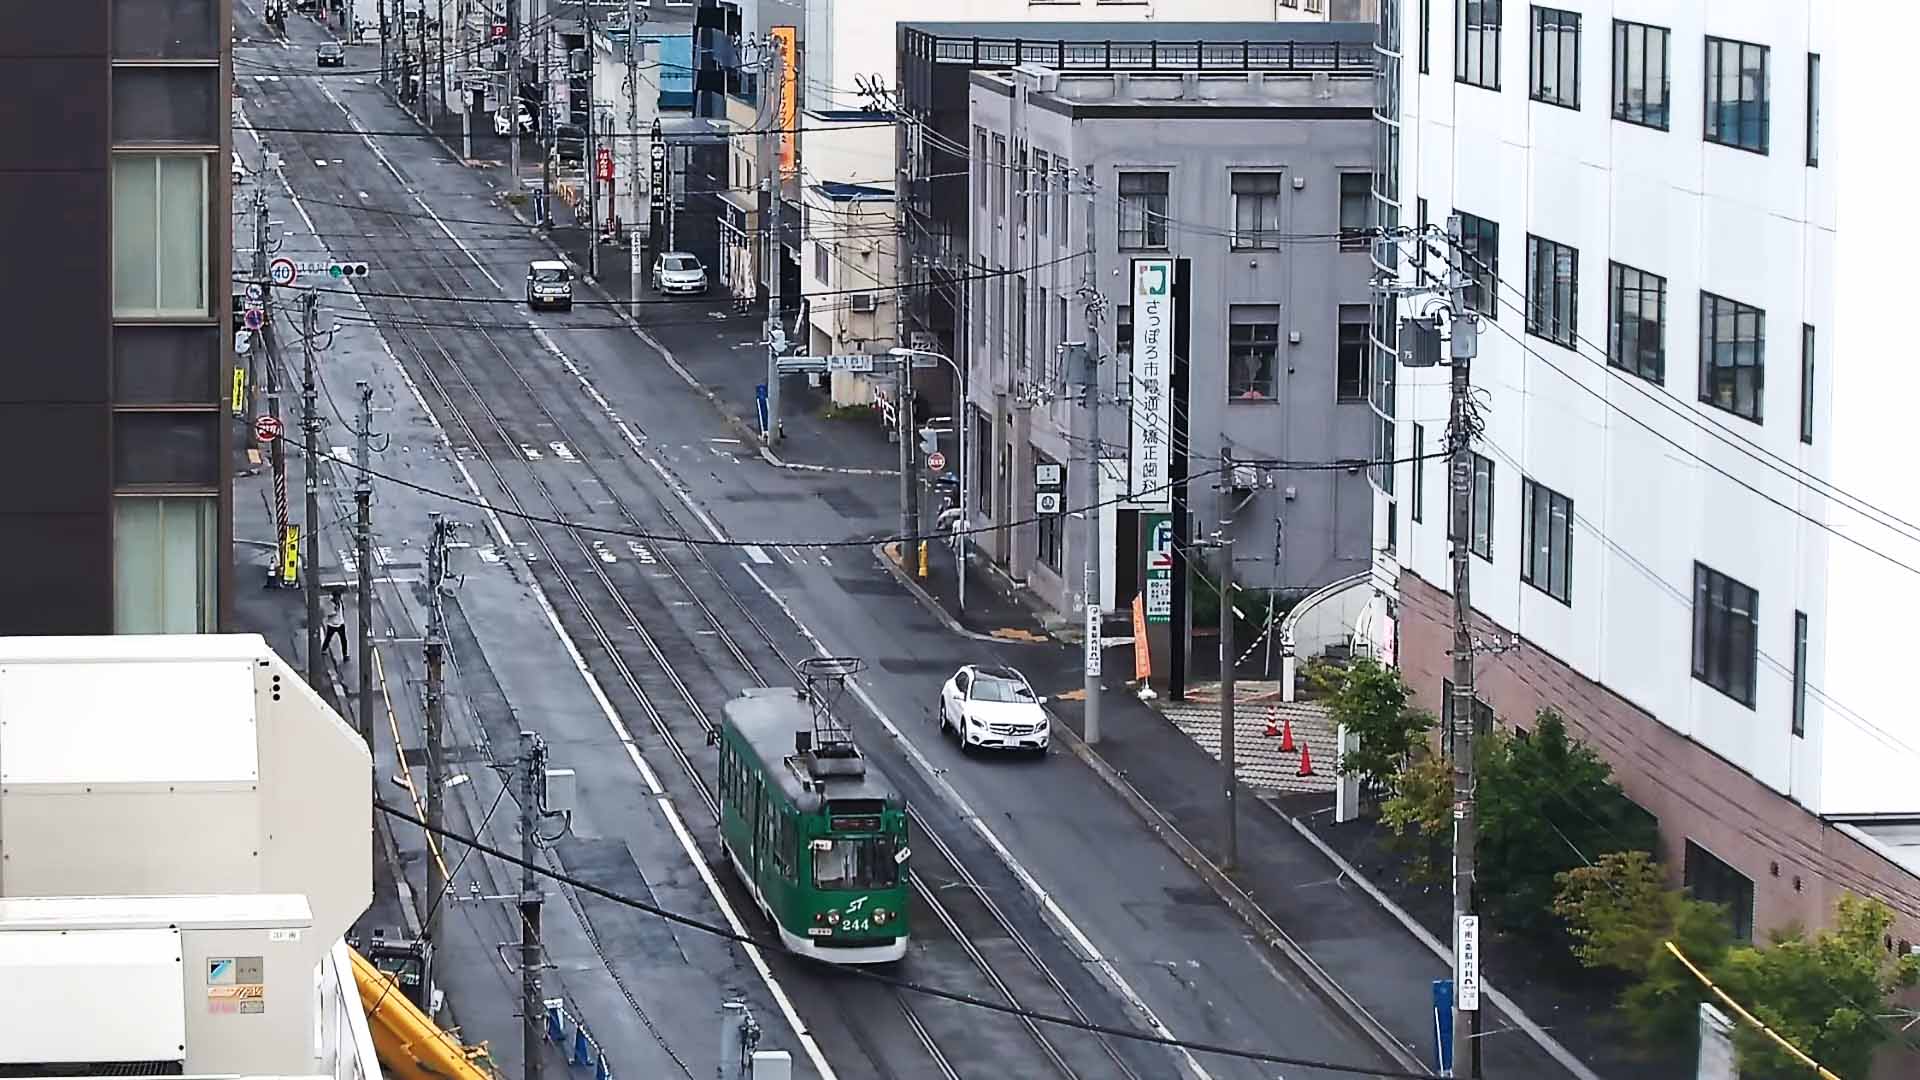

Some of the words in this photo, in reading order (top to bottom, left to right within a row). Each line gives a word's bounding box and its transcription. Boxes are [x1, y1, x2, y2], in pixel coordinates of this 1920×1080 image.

[273, 266, 290, 279] 40
[845, 895, 869, 914] ST
[842, 919, 869, 931] 244
